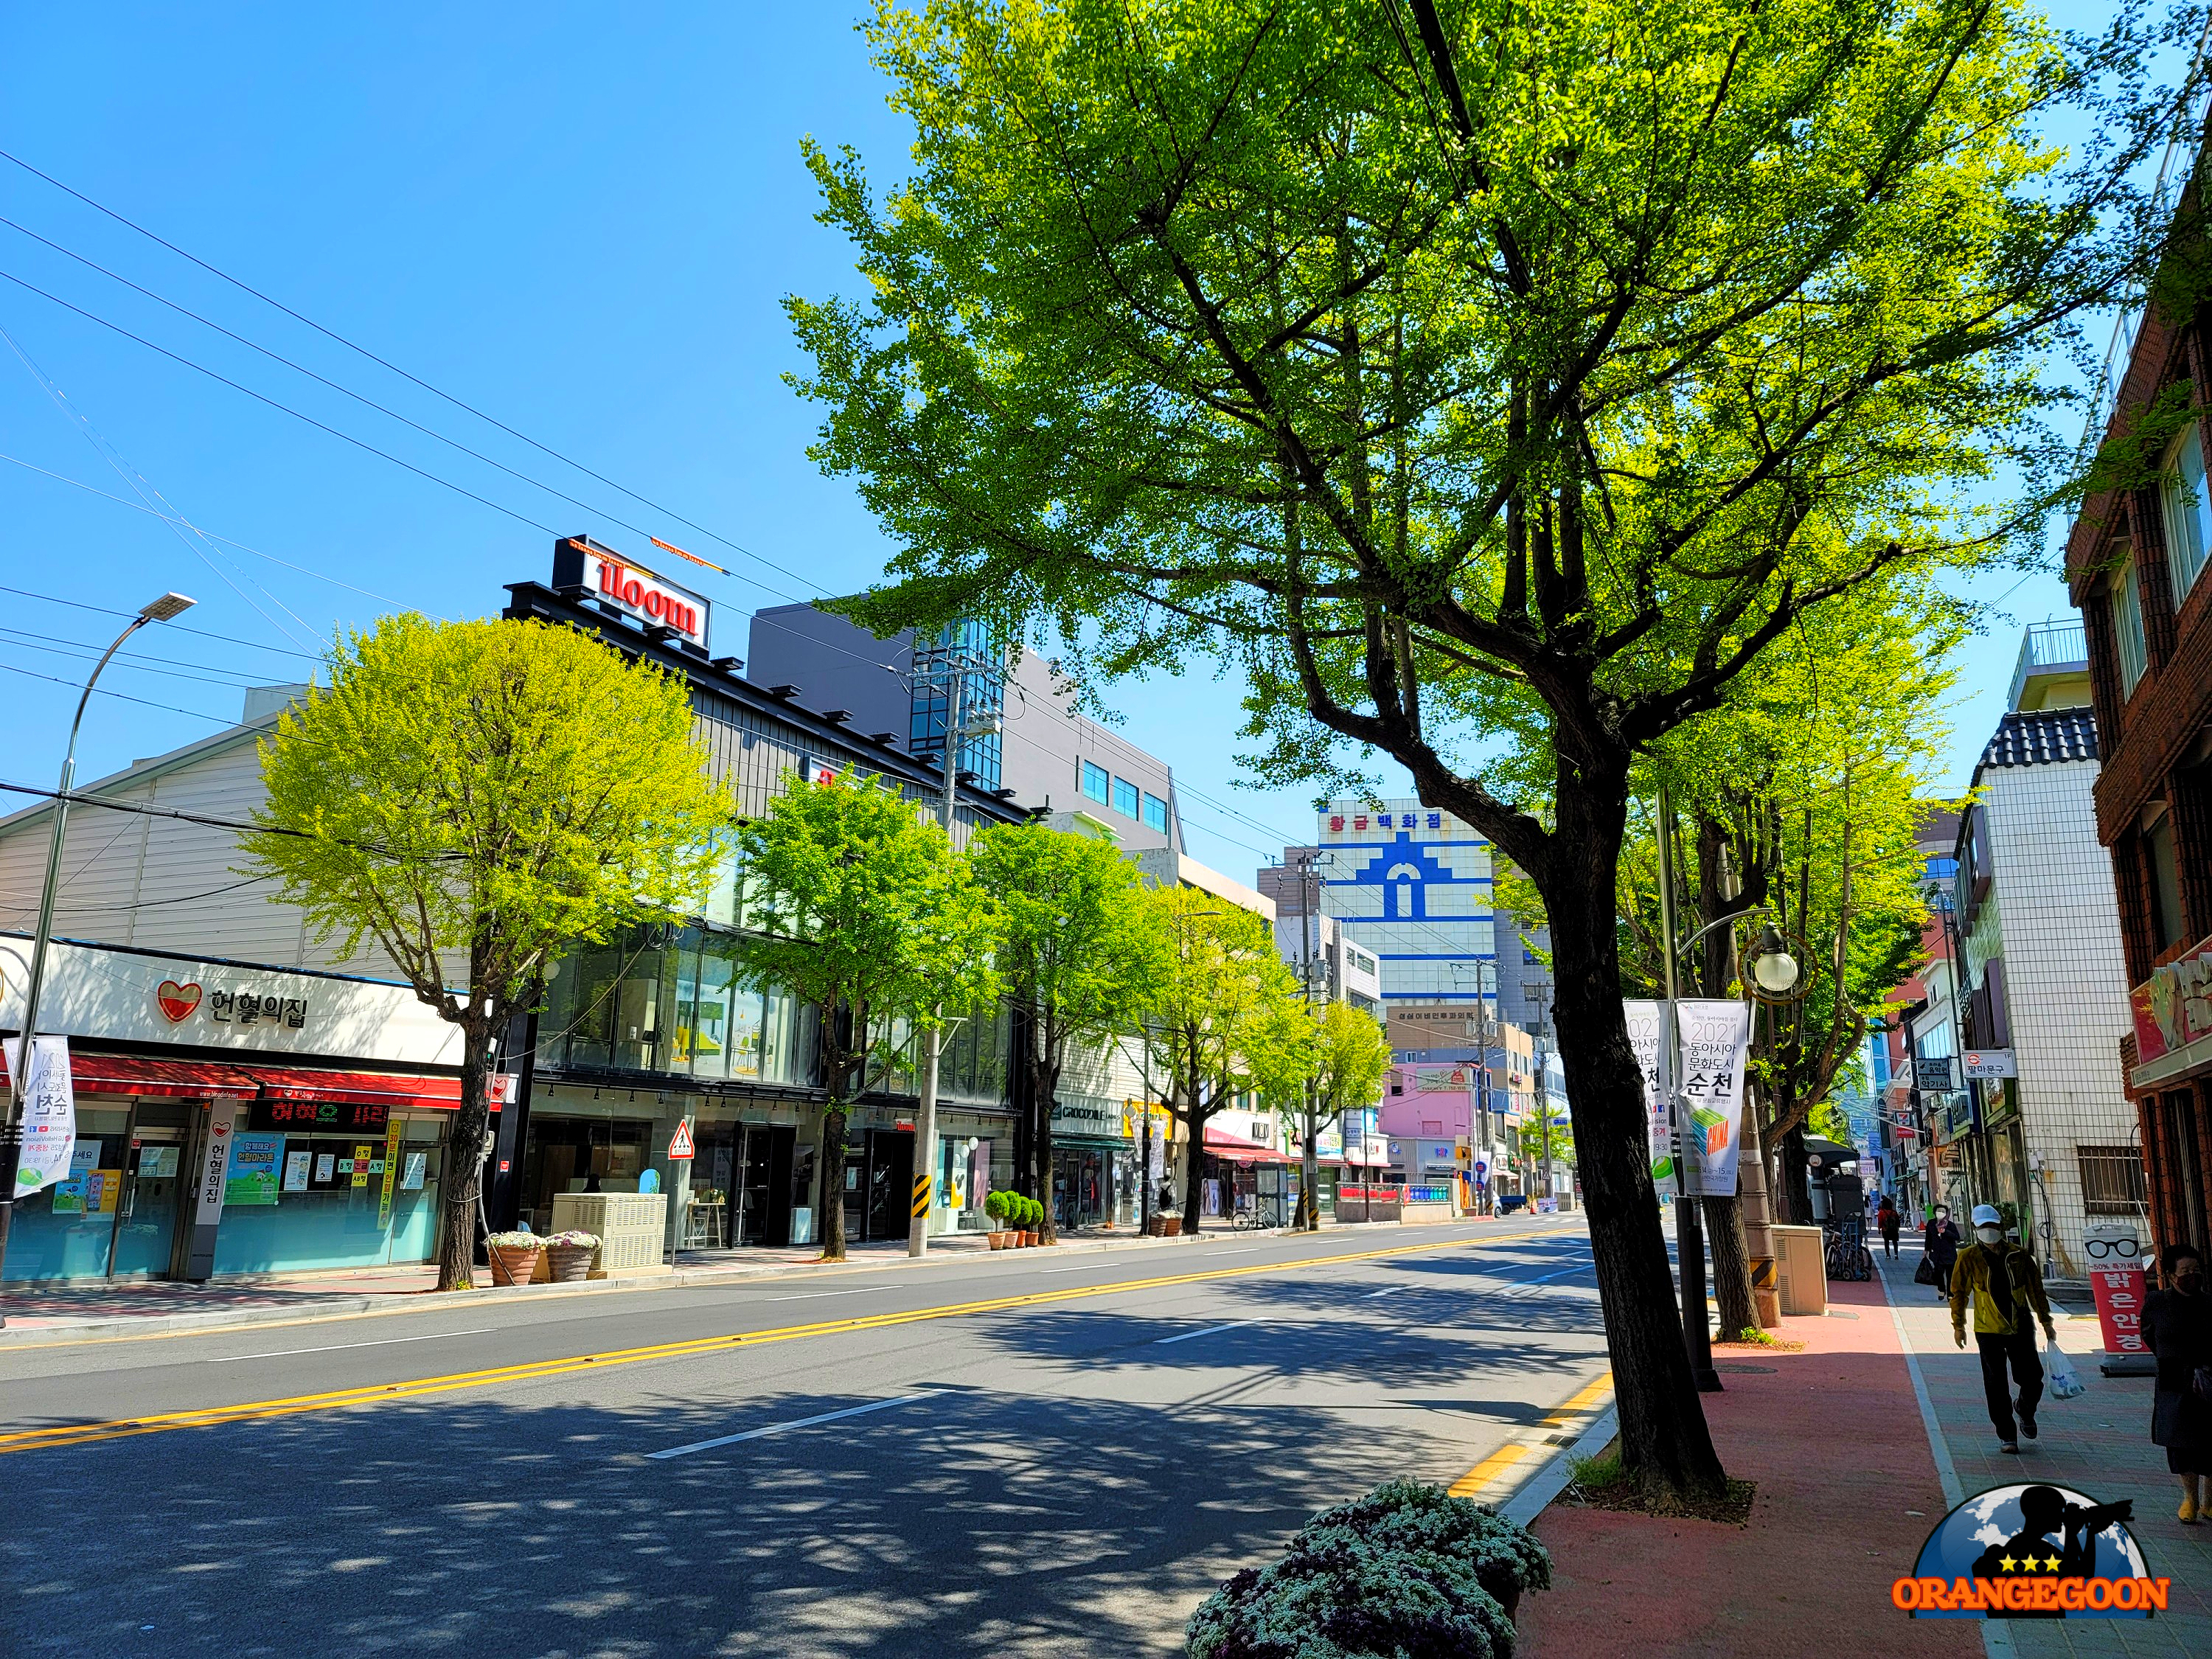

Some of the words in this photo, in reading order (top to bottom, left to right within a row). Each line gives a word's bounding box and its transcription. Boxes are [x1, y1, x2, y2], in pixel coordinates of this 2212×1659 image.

[599, 562, 698, 636] iloom
[1329, 813, 1441, 832] 황금백화점
[208, 990, 307, 1029] 헌혈의집
[1691, 1022, 1736, 1043] 2021
[1688, 1042, 1736, 1057] 동아시아
[1688, 1057, 1734, 1071] 문화도시
[1967, 1065, 2005, 1074] 팔마문구
[1686, 1073, 1733, 1097] 순천
[1921, 1081, 1948, 1089] 악기사
[1062, 1107, 1105, 1121] CROCODILE
[897, 1121, 916, 1132] iloom
[1707, 1119, 1729, 1157] CHINA
[237, 1152, 275, 1163] 헌혈마라톤
[363, 1150, 369, 1158] 형
[346, 1162, 352, 1170] 형
[355, 1162, 368, 1170] 긴급
[376, 1163, 383, 1171] 형
[205, 1144, 225, 1203] 헌혈의집
[361, 1175, 366, 1183] 형
[2104, 1272, 2143, 1350] 밝은안경
